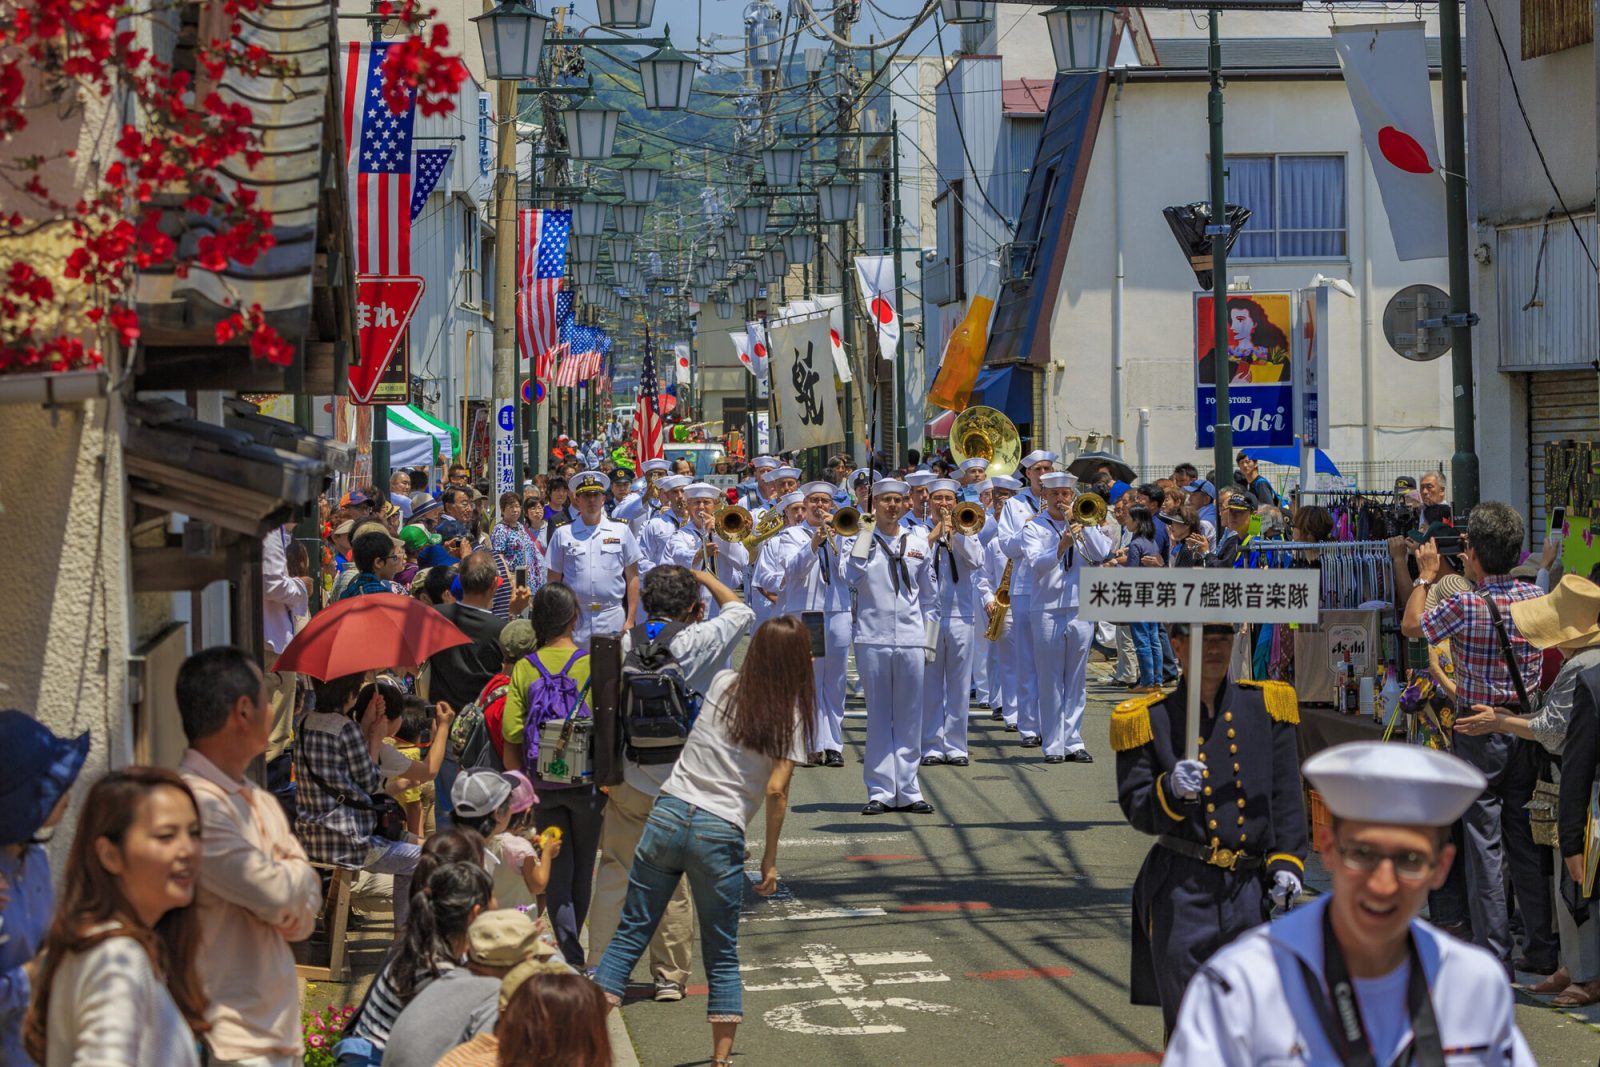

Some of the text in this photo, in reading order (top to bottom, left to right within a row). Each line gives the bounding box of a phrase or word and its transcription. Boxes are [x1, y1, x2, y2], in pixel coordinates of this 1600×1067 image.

[1206, 406, 1286, 432] oki
[1089, 580, 1309, 609] 米海軍第7艦隊音楽隊
